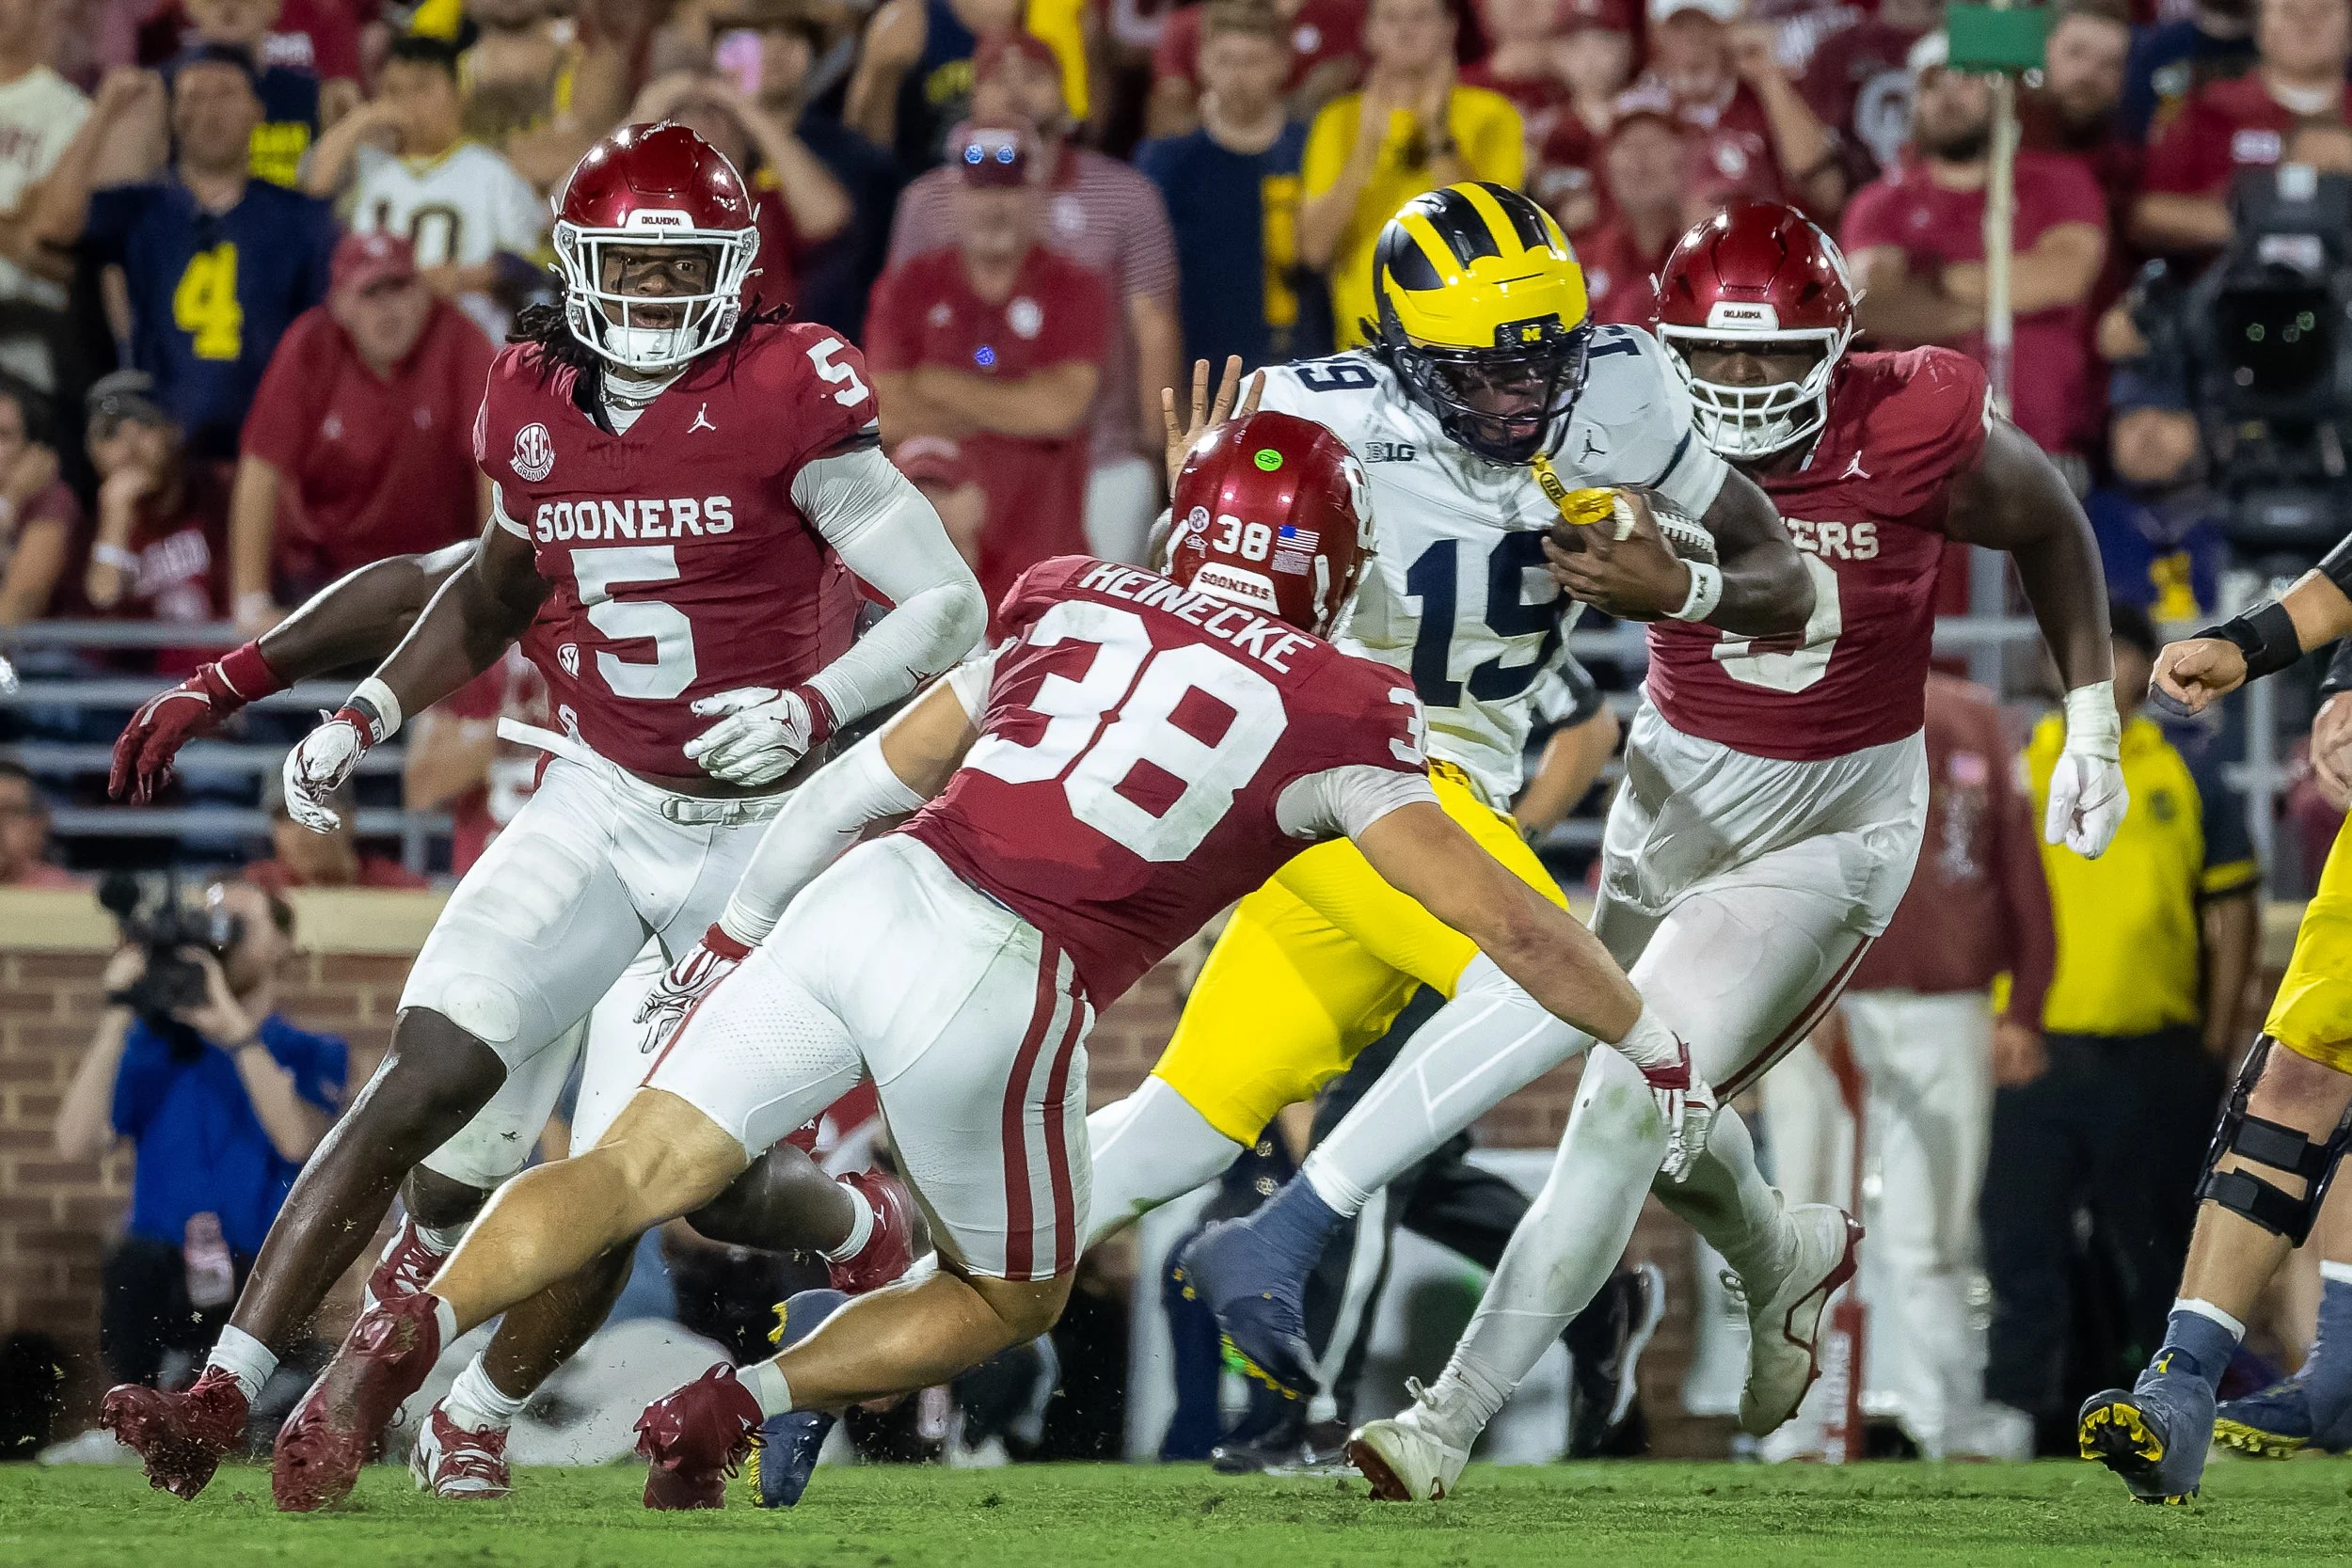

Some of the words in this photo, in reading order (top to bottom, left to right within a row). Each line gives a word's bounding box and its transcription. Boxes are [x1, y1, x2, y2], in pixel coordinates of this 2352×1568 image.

[642, 215, 681, 226] OKLAHOMA
[173, 241, 241, 360] 4
[1724, 309, 1762, 320] OKLAHOMA
[806, 337, 869, 407] 5
[517, 425, 548, 468] SEC
[535, 495, 734, 543] SOONERS
[1212, 514, 1272, 562] 38
[1779, 516, 1880, 561] ERS
[1200, 571, 1270, 600] SOONERS
[569, 545, 698, 700] 5
[1077, 562, 1317, 674] HEINECKE
[1406, 530, 1568, 708] 19
[960, 599, 1290, 863] 38
